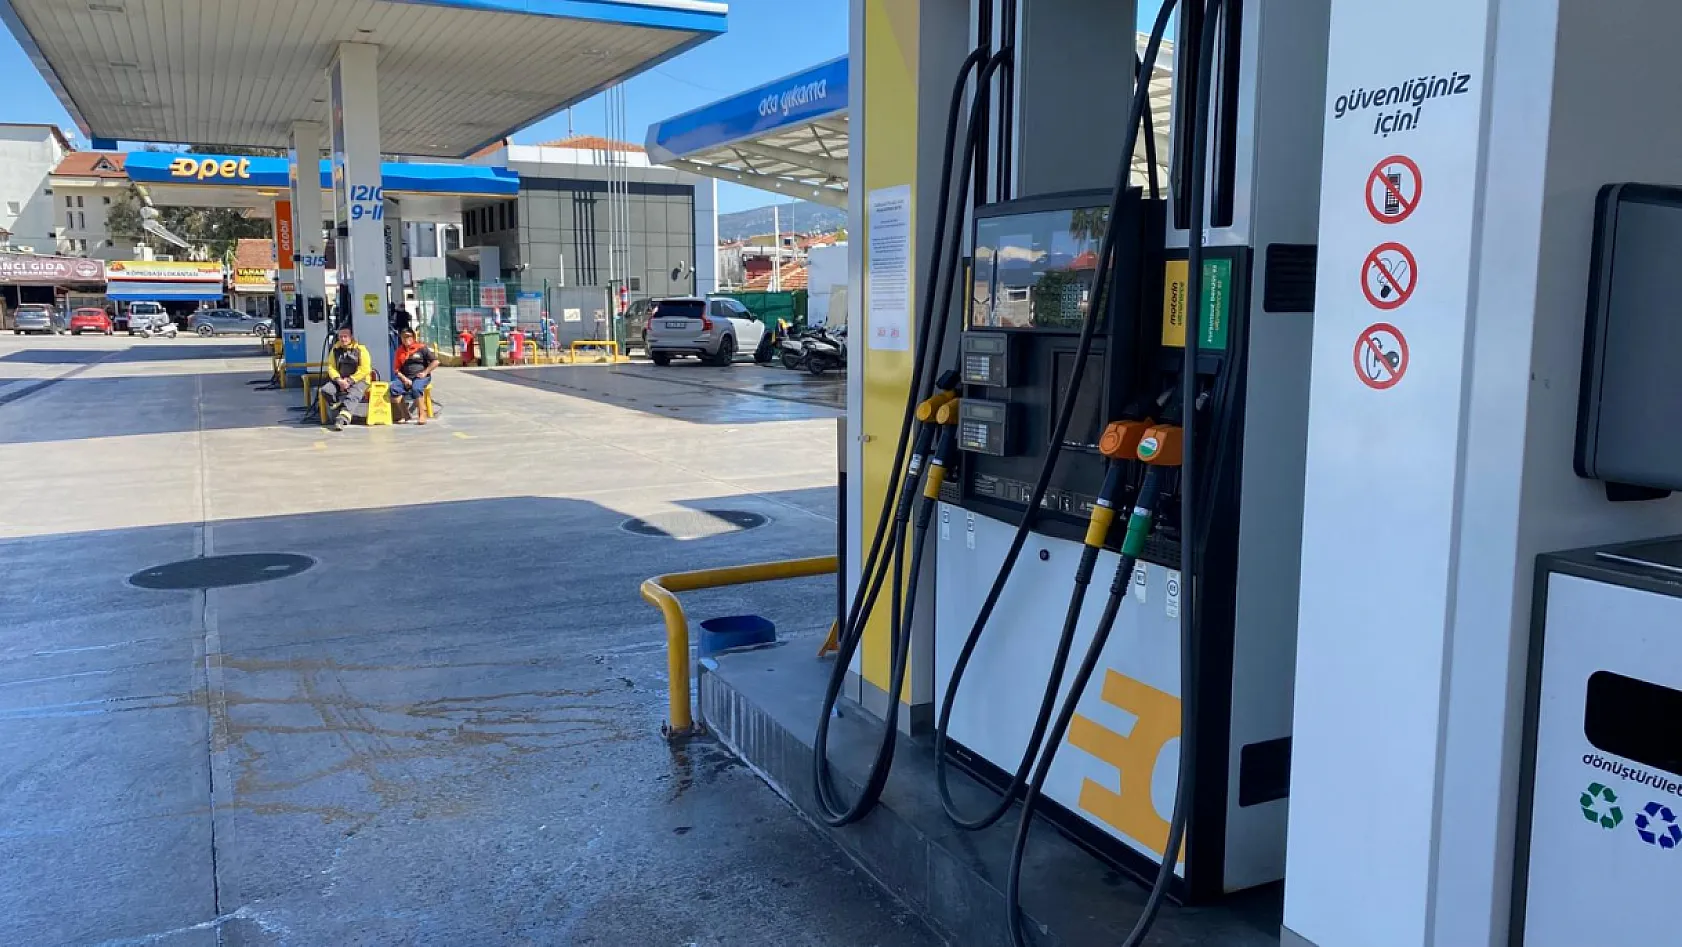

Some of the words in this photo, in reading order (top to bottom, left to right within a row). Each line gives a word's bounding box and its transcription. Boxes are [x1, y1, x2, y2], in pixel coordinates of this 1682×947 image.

[758, 93, 779, 116] oto
[781, 78, 827, 116] yıkama
[1334, 72, 1471, 119] güvenliğiniz
[1373, 108, 1422, 138] için!
[169, 157, 251, 180] opet
[281, 219, 291, 251] otobil
[0, 262, 27, 271] NCI
[1170, 281, 1179, 326] motorin
